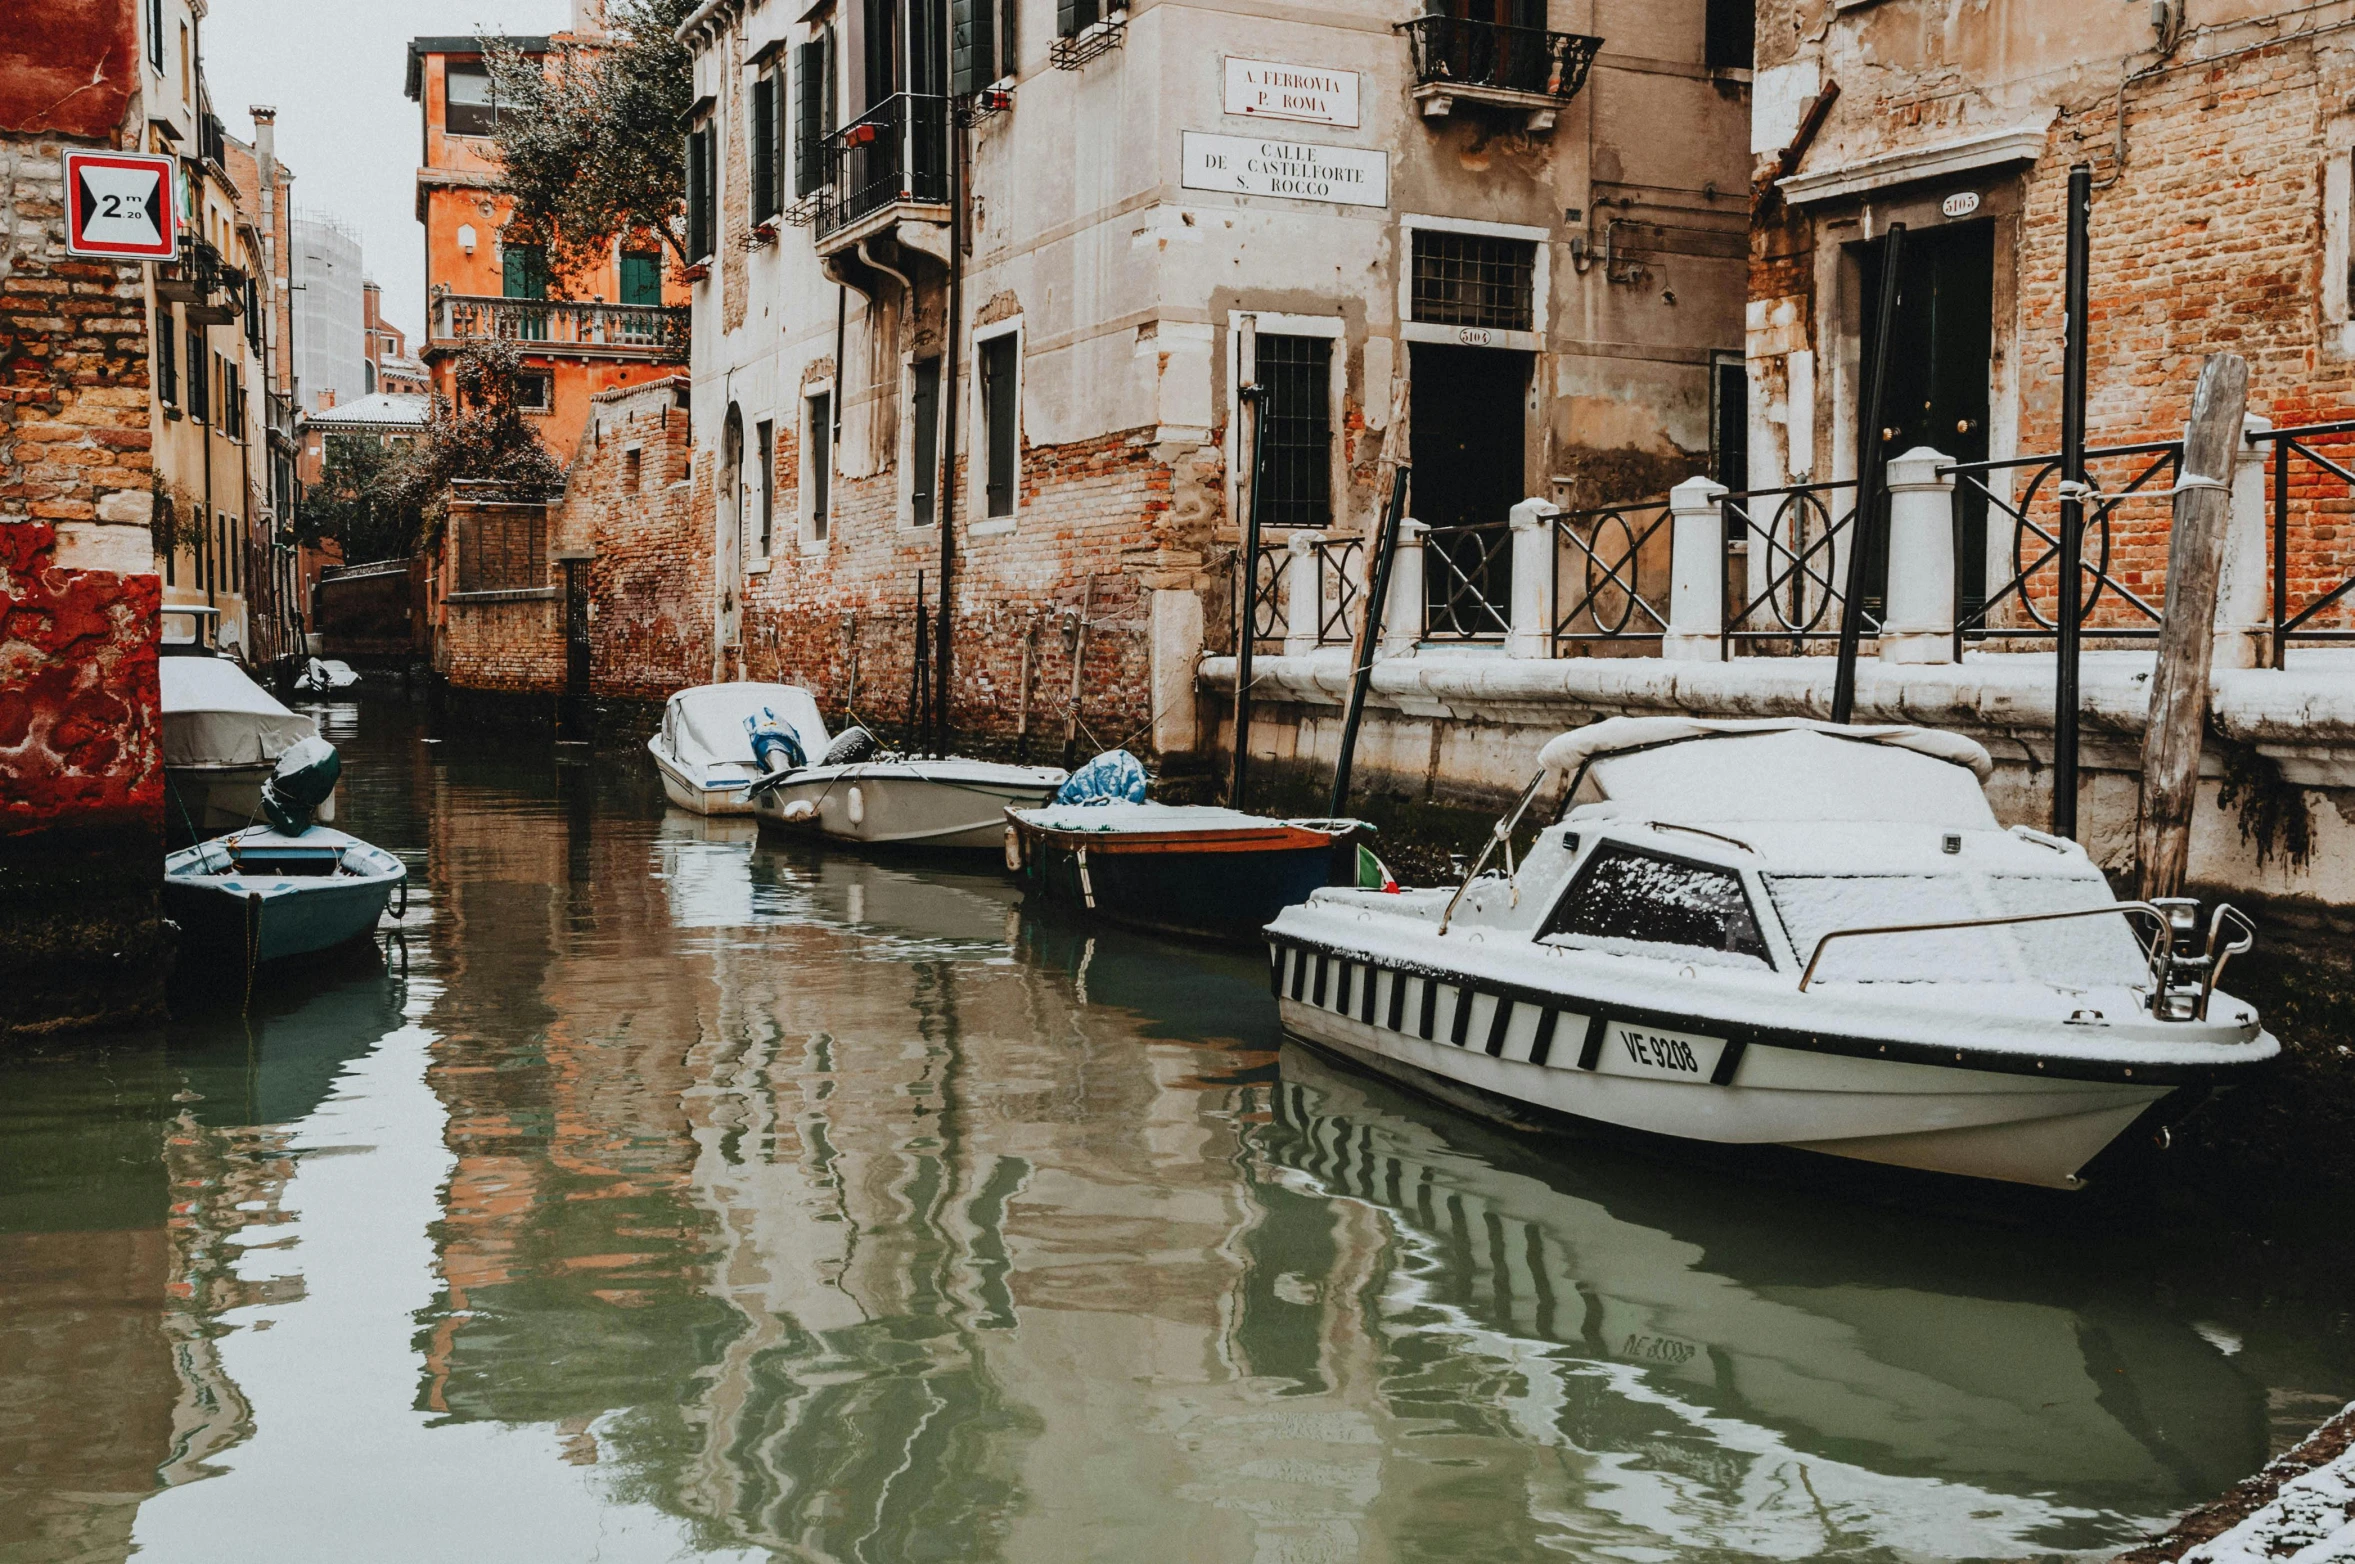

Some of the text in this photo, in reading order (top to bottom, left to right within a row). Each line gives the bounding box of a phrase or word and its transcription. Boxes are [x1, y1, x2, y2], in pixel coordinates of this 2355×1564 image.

[1244, 70, 1340, 94] A. FERROVIA
[1258, 91, 1327, 113] P. ROMA
[1261, 143, 1318, 163] CALLE
[1205, 154, 1366, 184] DE CASTELFORTE
[1236, 174, 1330, 197] S. ROCCO
[102, 194, 122, 218] 2
[1620, 1030, 1698, 1073] VE 9208
